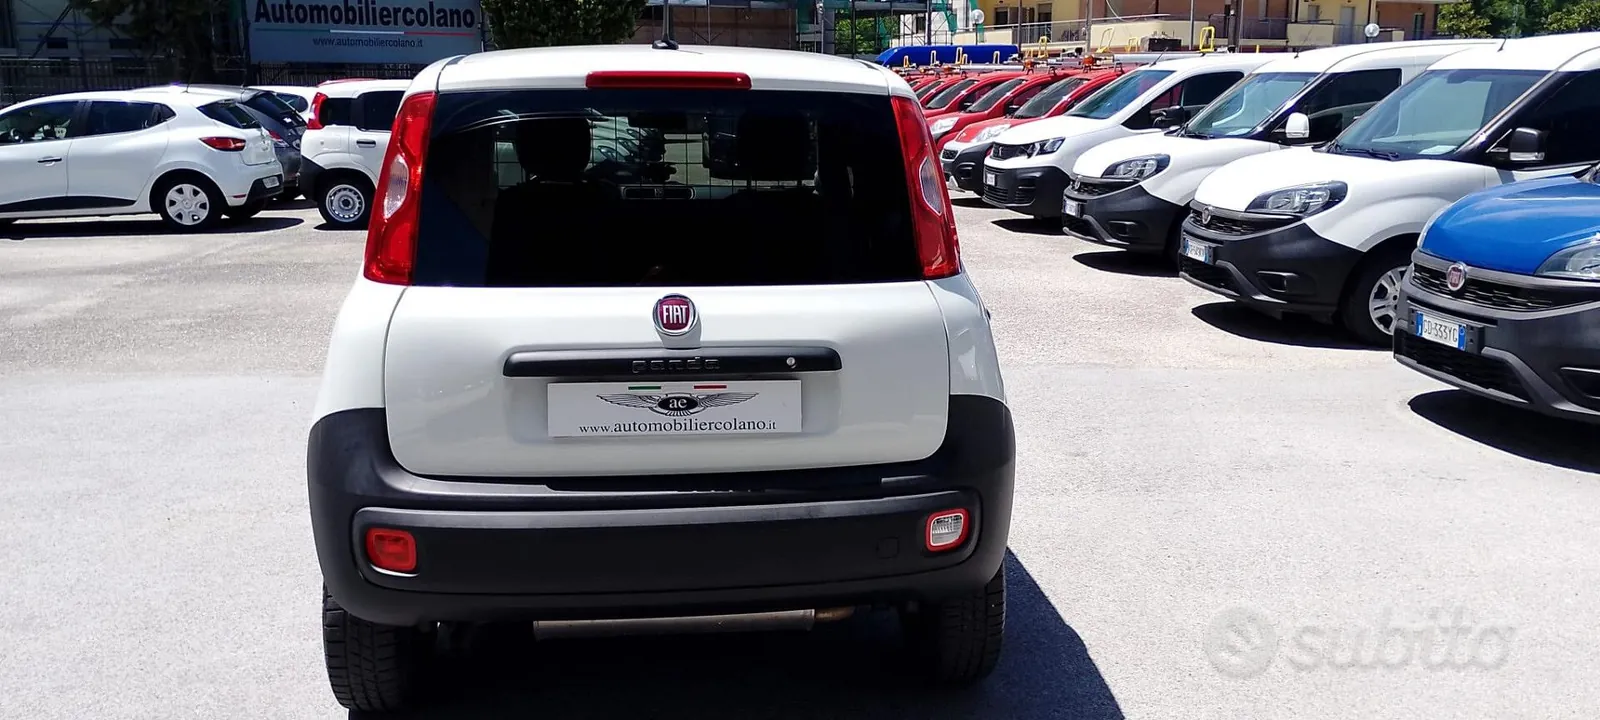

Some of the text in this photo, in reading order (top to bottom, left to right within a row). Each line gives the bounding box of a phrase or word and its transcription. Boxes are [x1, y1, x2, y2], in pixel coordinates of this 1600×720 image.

[254, 0, 475, 28] Automobiliercolano
[312, 36, 423, 48] www.automobiliercolano.it
[662, 304, 688, 324] FIAT
[632, 356, 720, 374] panda
[668, 397, 688, 410] ae
[579, 418, 776, 433] www.automobiliercolano.it
